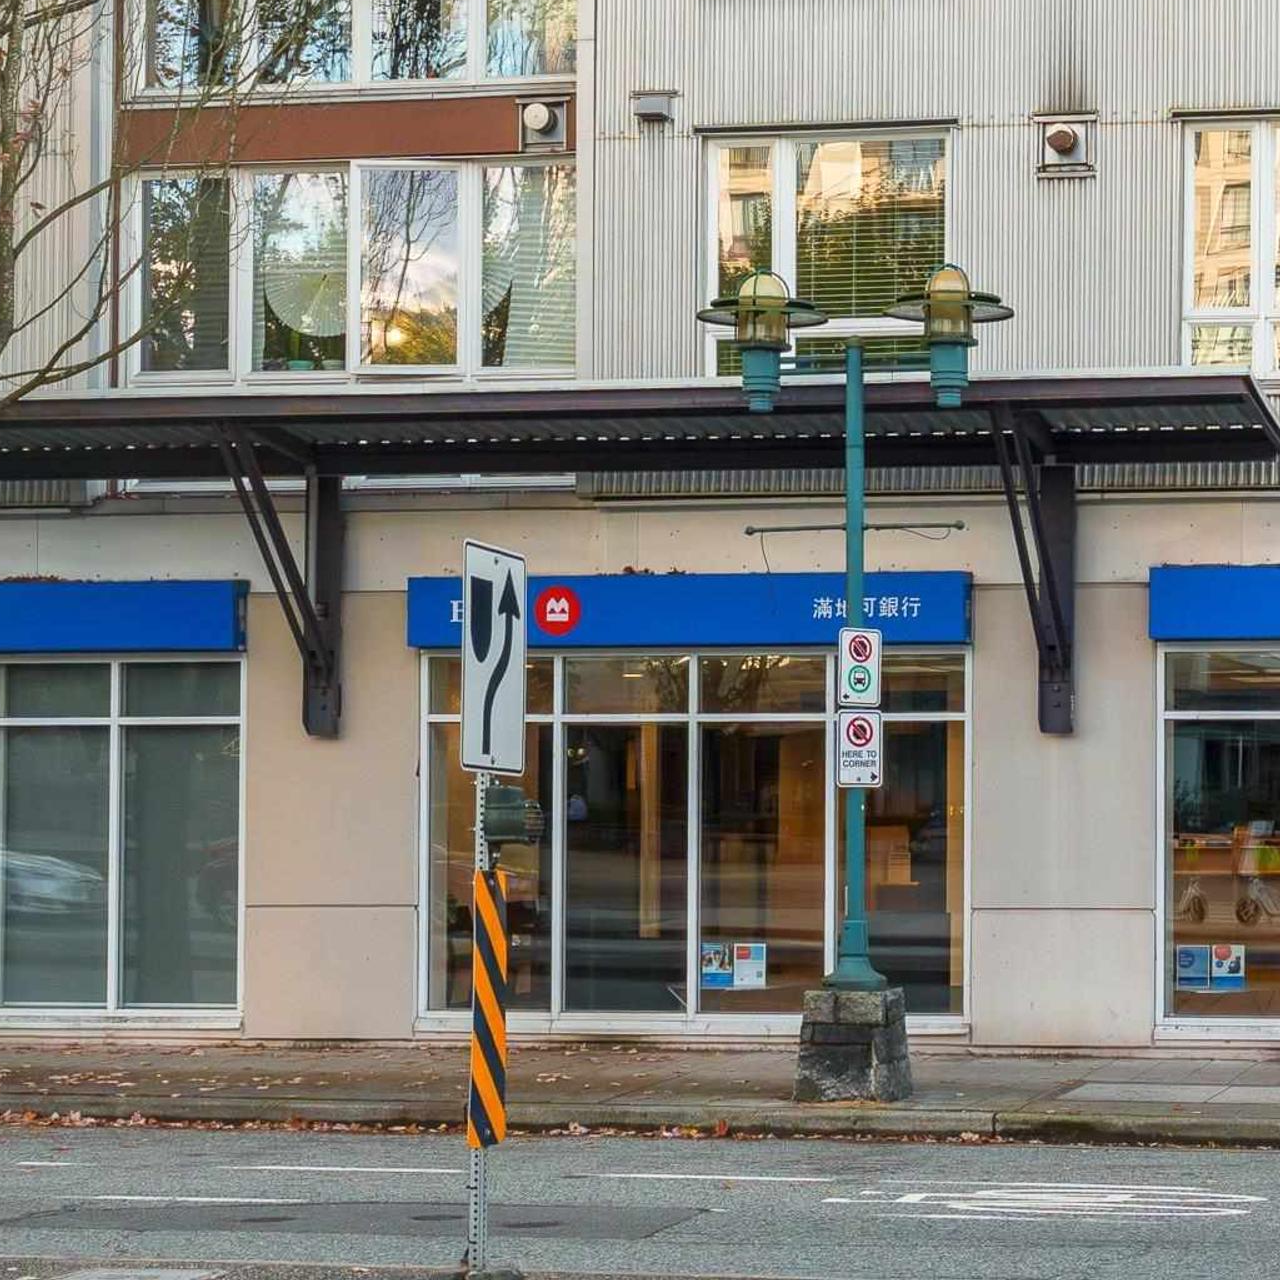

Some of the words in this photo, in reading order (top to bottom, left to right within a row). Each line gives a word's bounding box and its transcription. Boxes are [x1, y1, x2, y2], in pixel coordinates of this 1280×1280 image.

[841, 750, 864, 759] HERE
[866, 750, 878, 759] TO
[842, 760, 878, 768] CORNER
